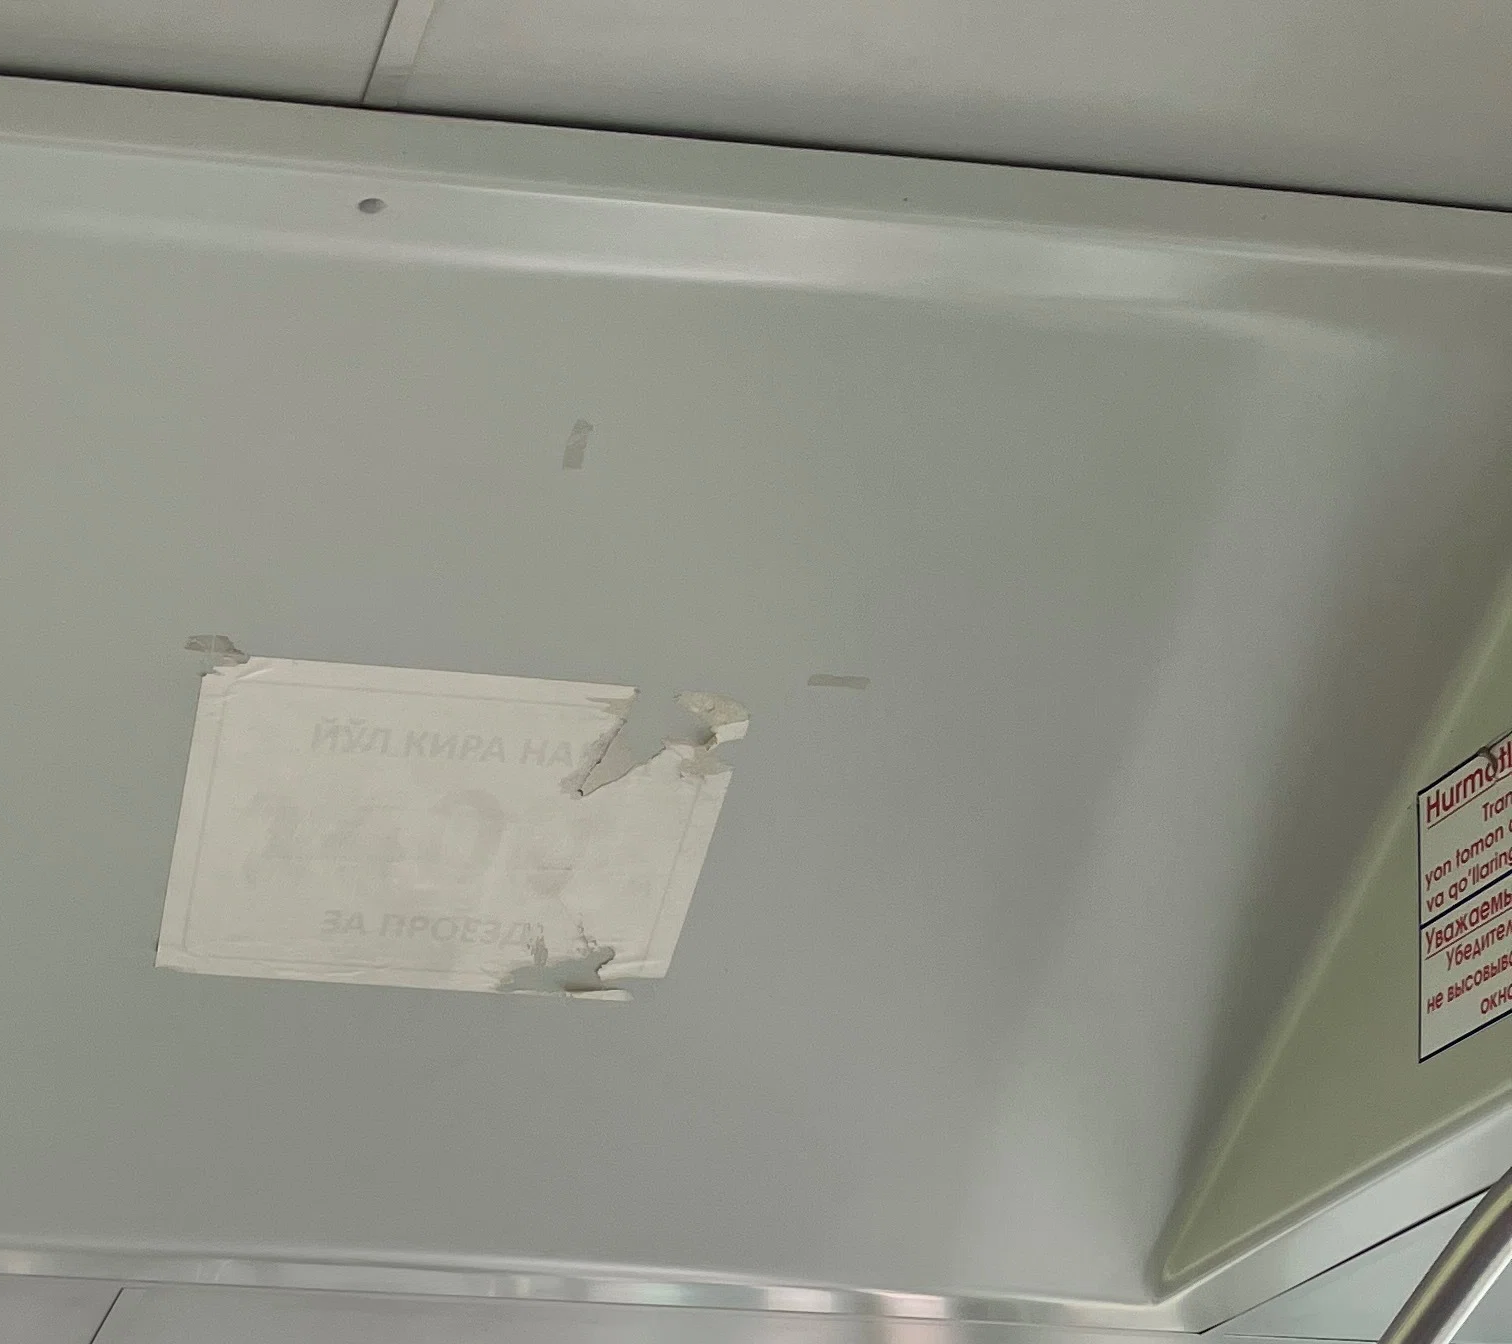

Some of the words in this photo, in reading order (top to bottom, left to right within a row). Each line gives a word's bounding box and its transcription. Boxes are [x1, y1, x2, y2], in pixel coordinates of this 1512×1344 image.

[403, 730, 506, 764] КИРА
[1424, 862, 1452, 891] yon
[1456, 827, 1503, 867] tomon
[1426, 894, 1444, 913] va
[319, 909, 366, 936] ЗА
[1427, 990, 1444, 1015] не
